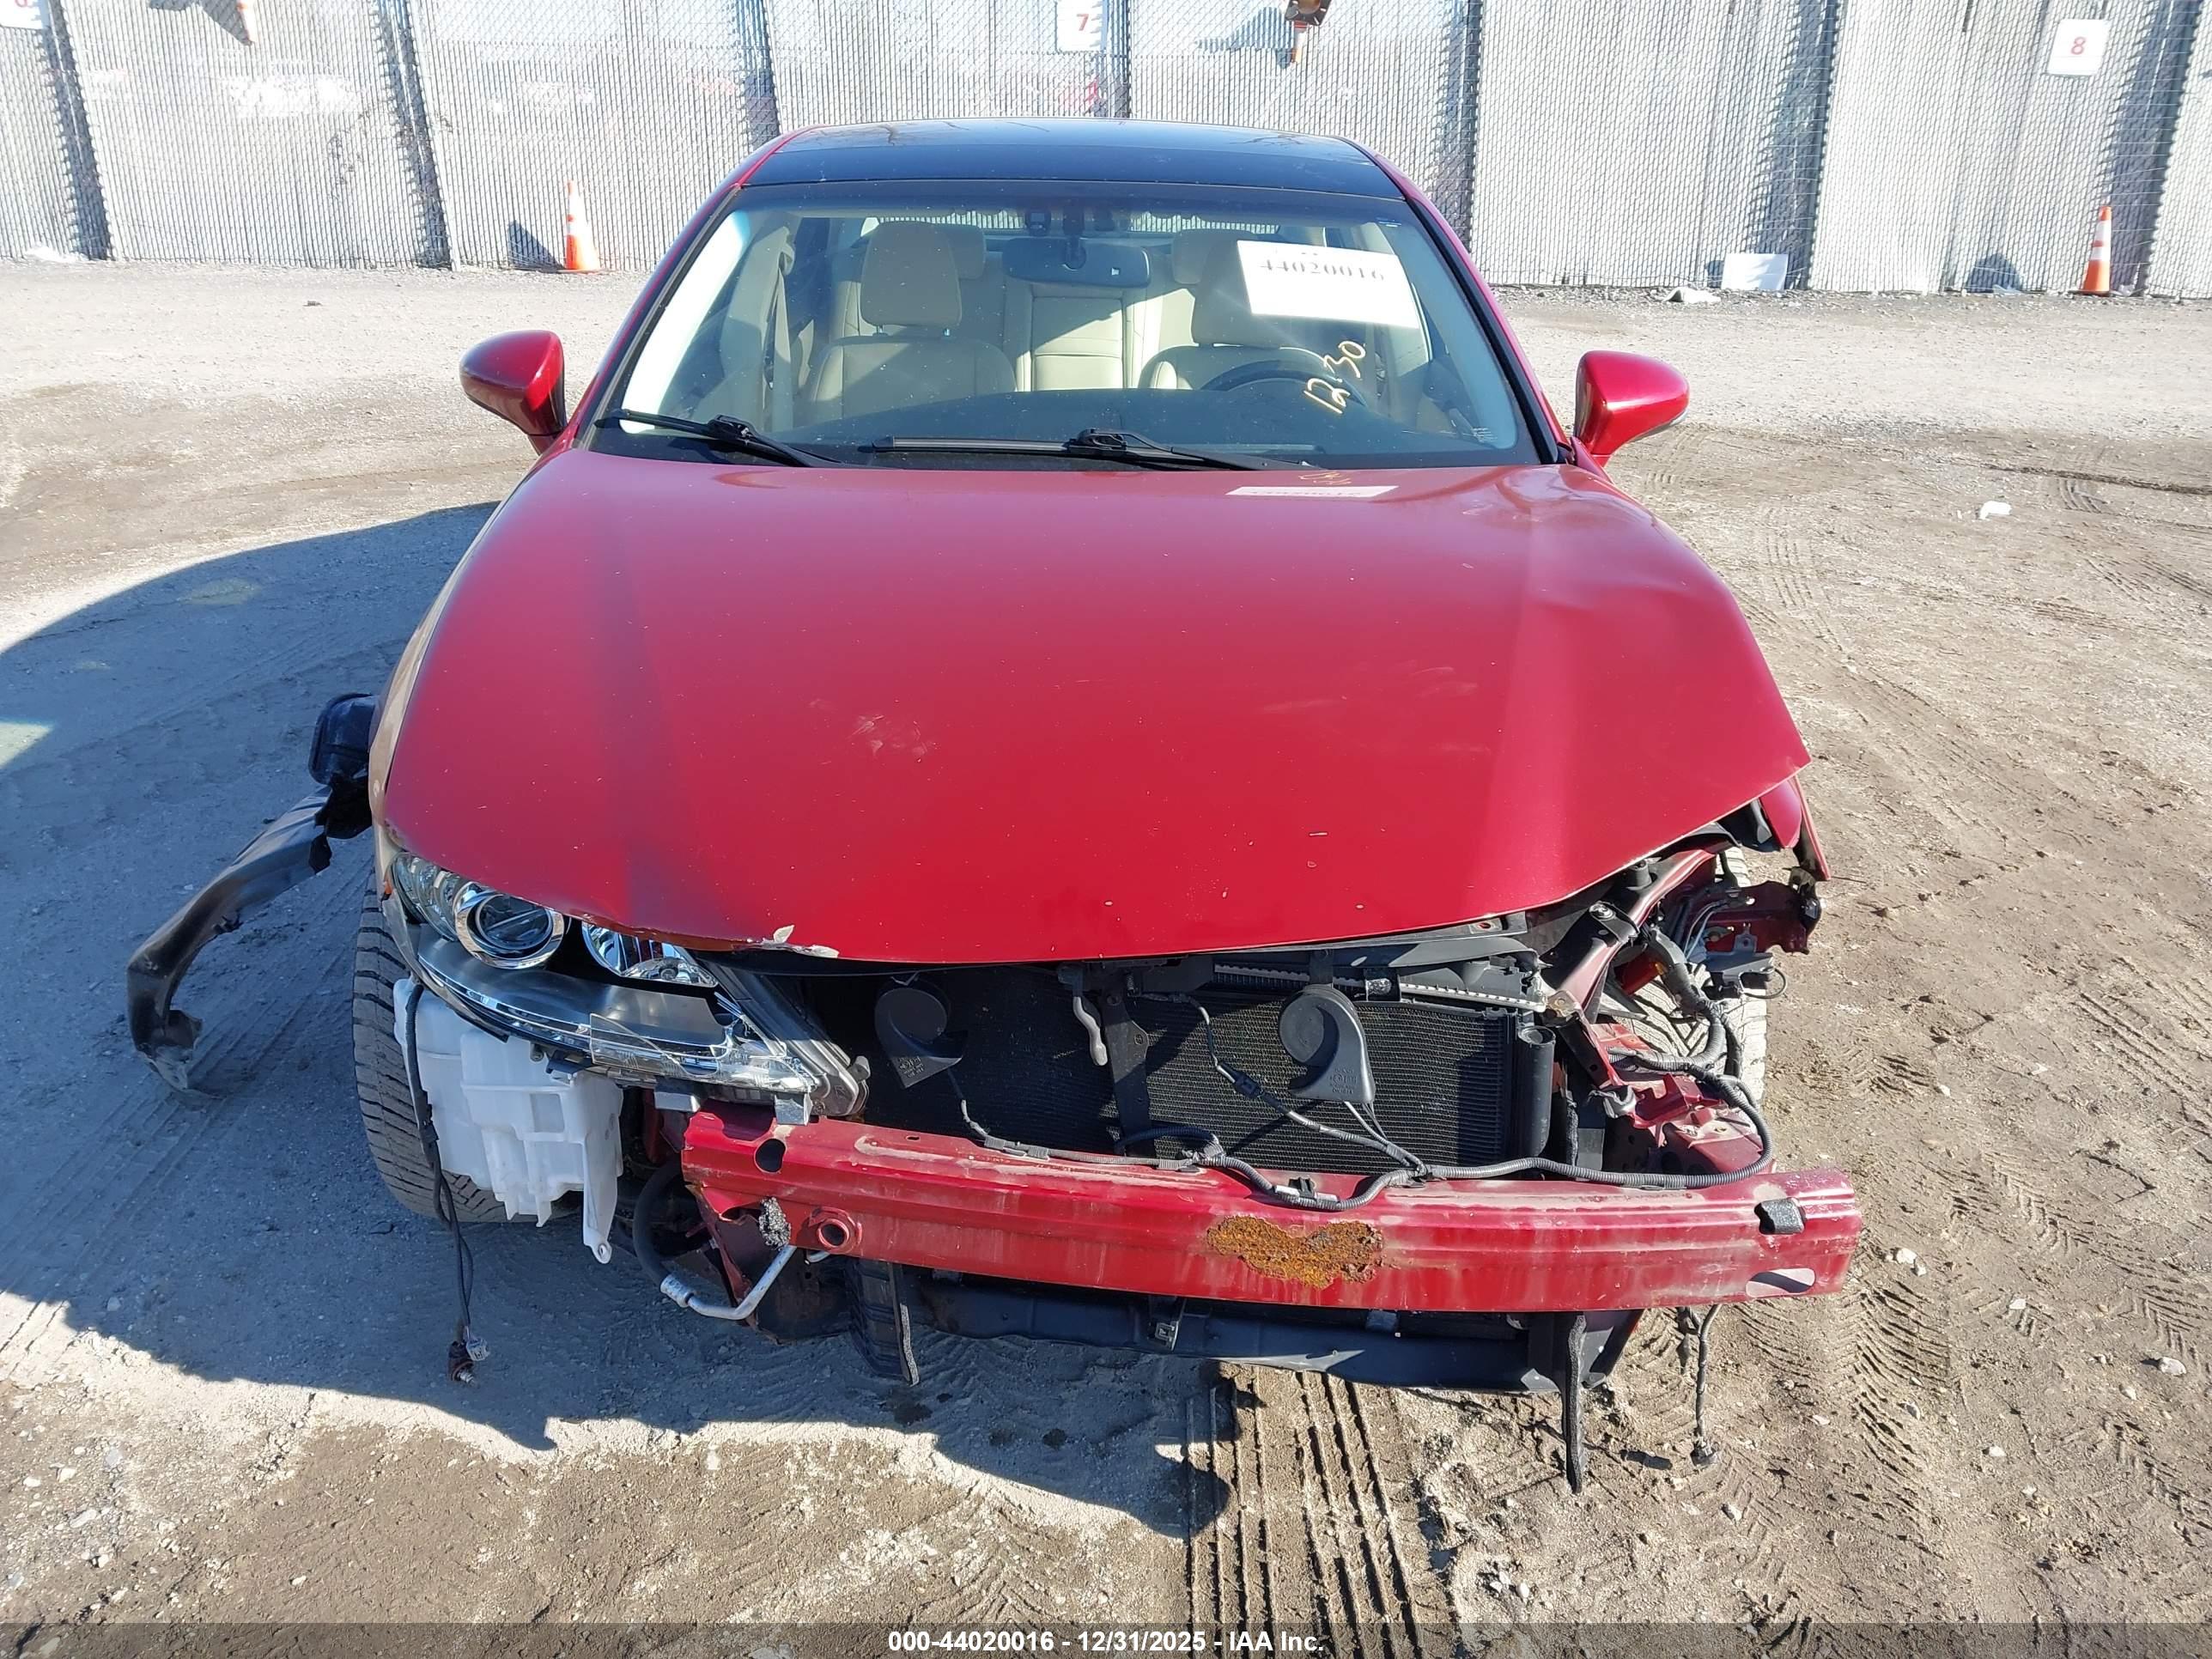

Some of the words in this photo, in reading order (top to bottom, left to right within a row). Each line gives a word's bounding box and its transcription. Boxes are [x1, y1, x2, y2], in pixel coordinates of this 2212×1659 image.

[1077, 13, 1089, 31] 7
[2071, 37, 2086, 55] 8
[1260, 258, 1385, 282] 44020016
